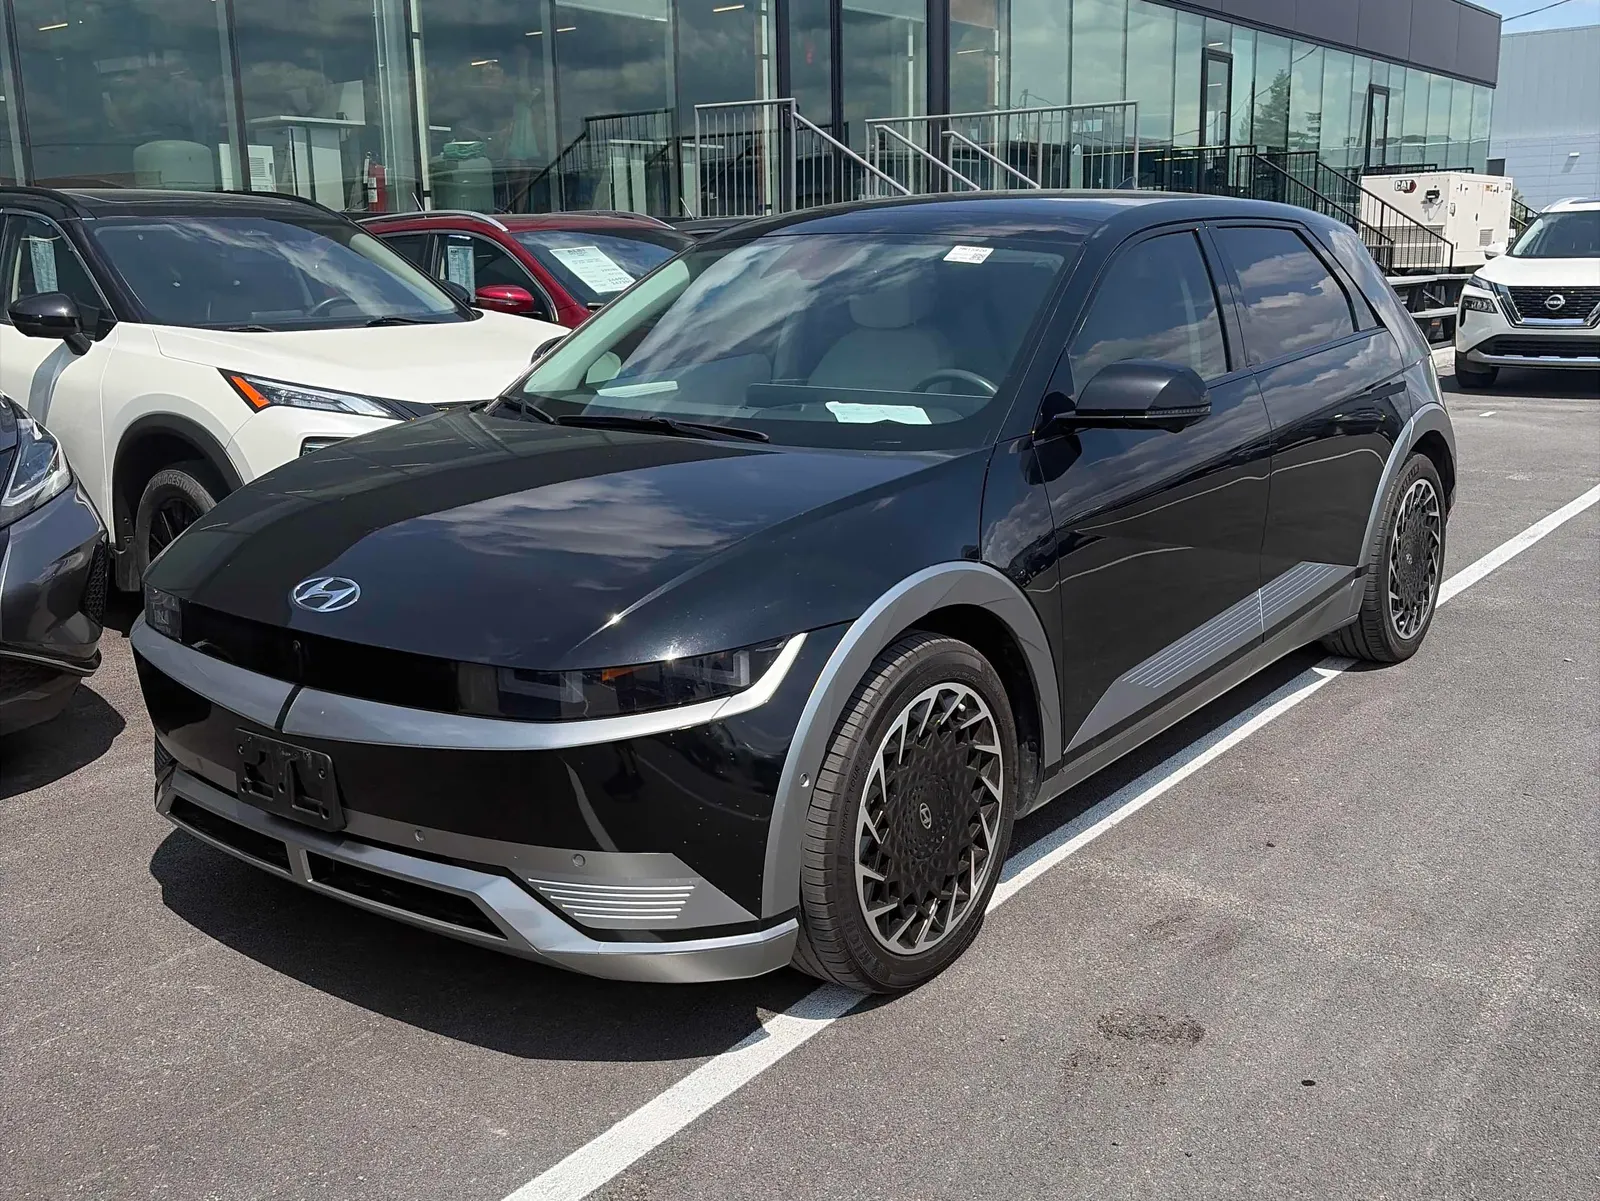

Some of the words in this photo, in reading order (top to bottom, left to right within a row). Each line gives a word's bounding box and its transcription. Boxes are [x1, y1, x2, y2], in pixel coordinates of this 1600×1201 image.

[1395, 180, 1411, 190] CAT
[840, 799, 852, 845] PRIMACY
[848, 764, 861, 793] TOUR
